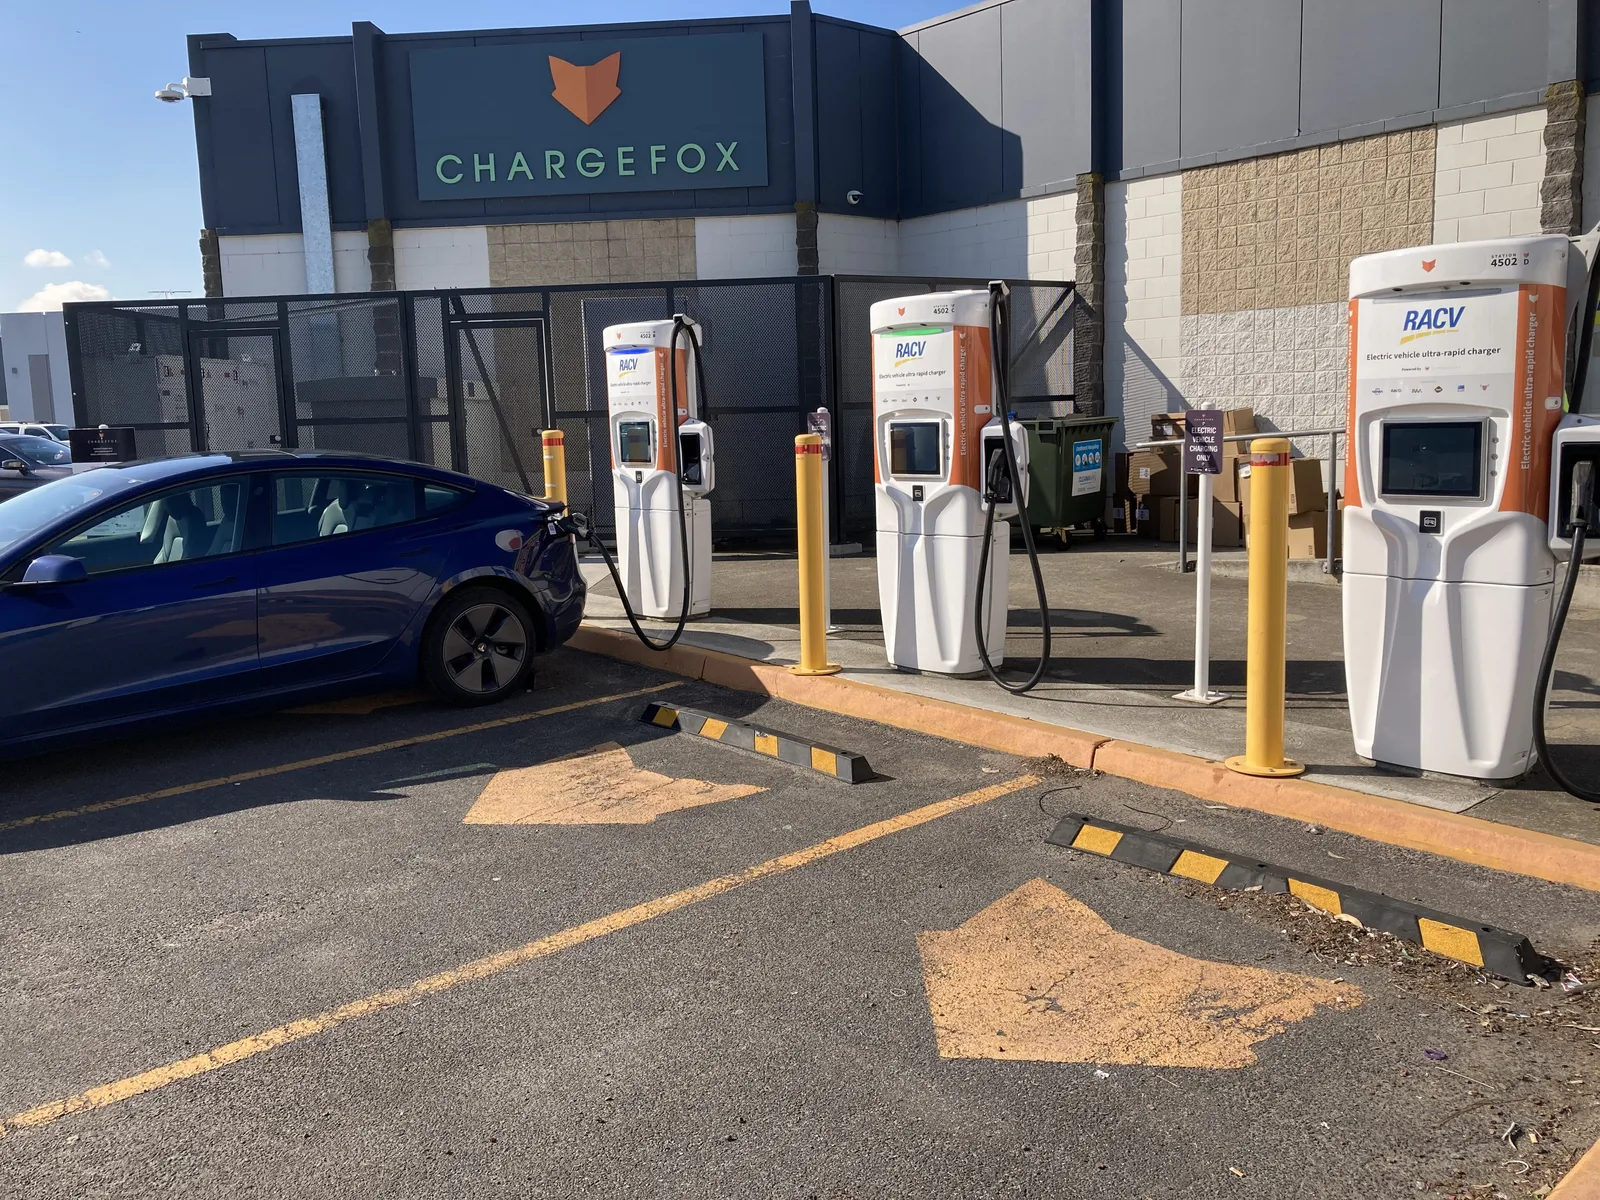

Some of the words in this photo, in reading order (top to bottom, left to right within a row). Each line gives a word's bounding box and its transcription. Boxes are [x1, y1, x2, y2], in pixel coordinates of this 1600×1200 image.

[435, 141, 740, 184] CHARGEFOX
[1490, 257, 1518, 267] 4502
[1403, 306, 1465, 331] RACV
[1526, 312, 1538, 348] charger
[895, 341, 926, 358] RACV
[1394, 351, 1420, 359] vehicle
[1422, 348, 1466, 358] ultra-rapid
[1468, 347, 1501, 356] charger
[620, 358, 638, 371] RACV
[892, 371, 905, 379] vehicle
[905, 370, 928, 378] ultra-rapid
[1524, 348, 1536, 399] ultra-rapid
[1522, 400, 1532, 433] vehicle
[1521, 434, 1531, 470] Electric
